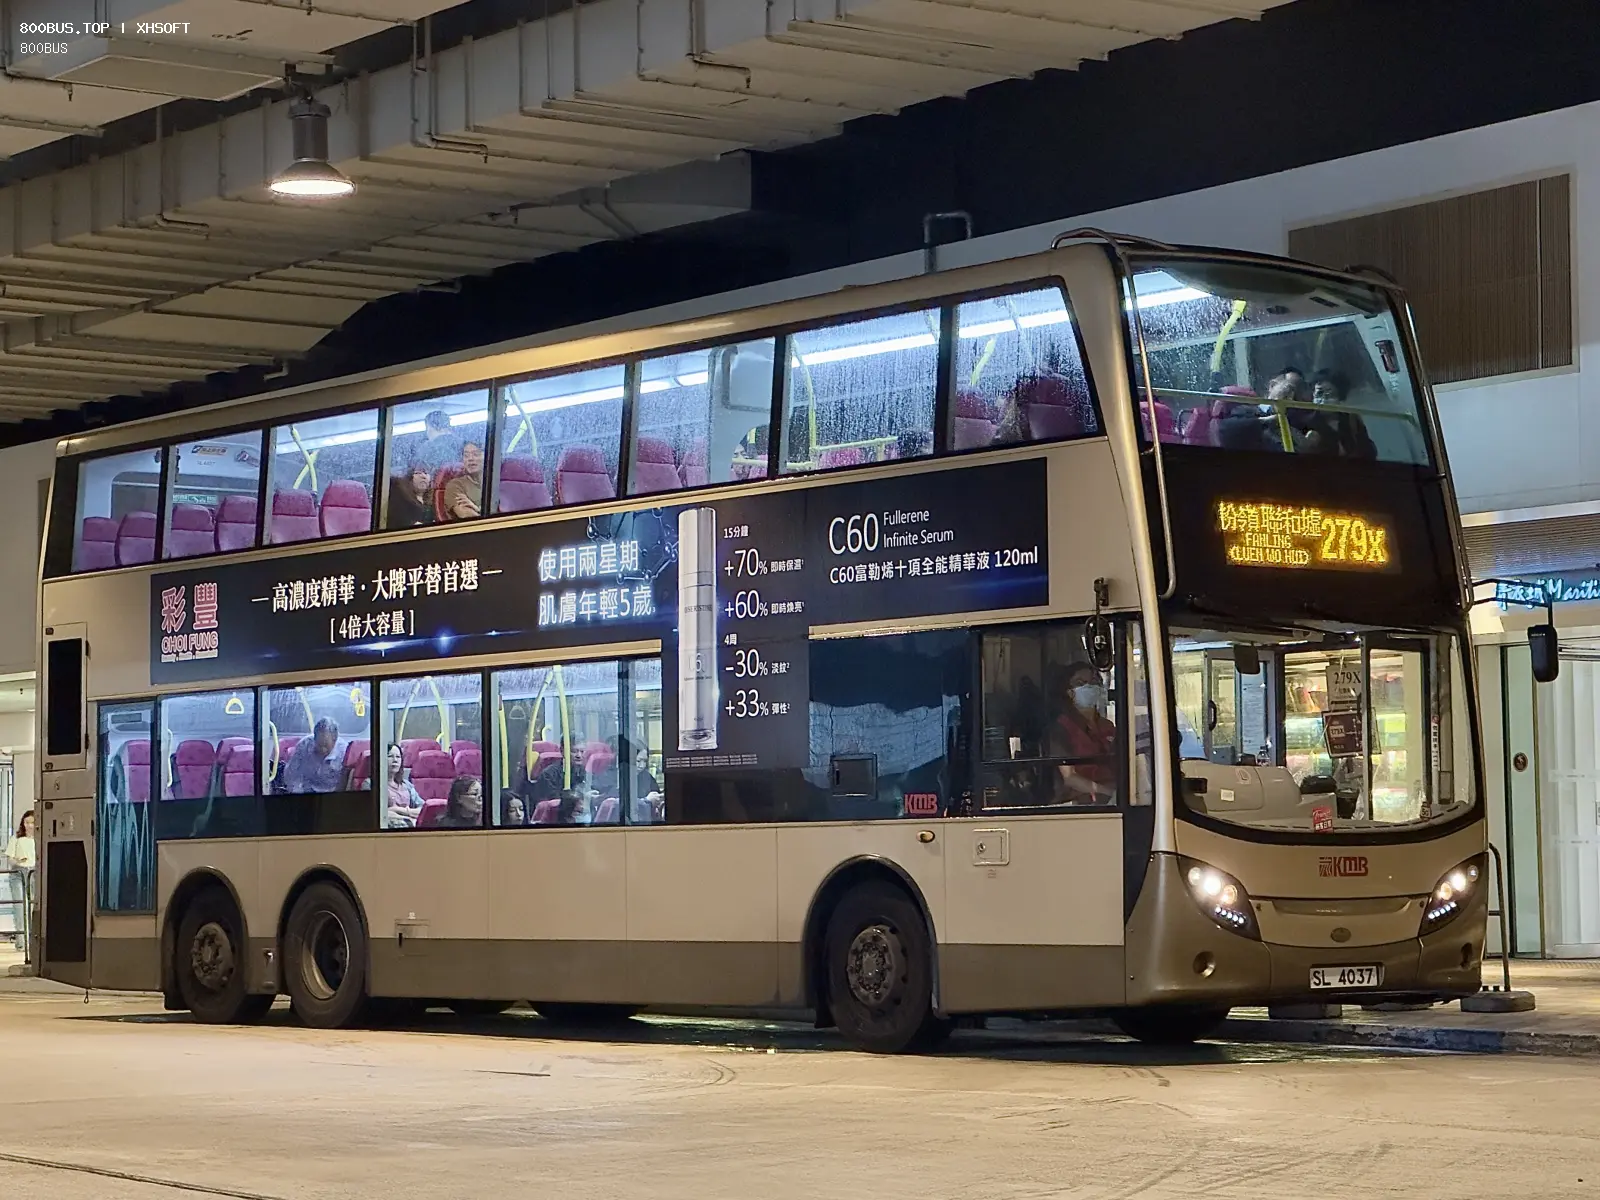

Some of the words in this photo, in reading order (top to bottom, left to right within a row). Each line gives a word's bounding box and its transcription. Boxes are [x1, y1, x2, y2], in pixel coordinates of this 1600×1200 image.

[883, 508, 930, 527] Fullerene
[723, 525, 749, 539] 15分鐘
[828, 513, 880, 555] C60
[883, 530, 918, 548] Infinite
[920, 528, 954, 545] Serum
[1245, 532, 1292, 549] FANLING
[1321, 518, 1387, 563] 279X
[538, 540, 639, 582] 使用兩星期
[724, 548, 768, 578] +70%
[829, 551, 990, 585] C60富勒烯十項全能精華液
[994, 546, 1039, 568] 120ml
[1266, 547, 1281, 563] WO
[161, 583, 219, 634] 彩豐
[724, 589, 769, 619] +60%
[161, 634, 187, 653] CHOI
[188, 631, 219, 651] FUNG
[725, 648, 768, 678] -30%
[1334, 671, 1361, 685] 279X
[725, 689, 769, 718] +33%
[904, 793, 938, 815] KMB
[1333, 856, 1369, 877] KMB
[1313, 970, 1331, 987] SL
[1338, 968, 1374, 985] 4037
